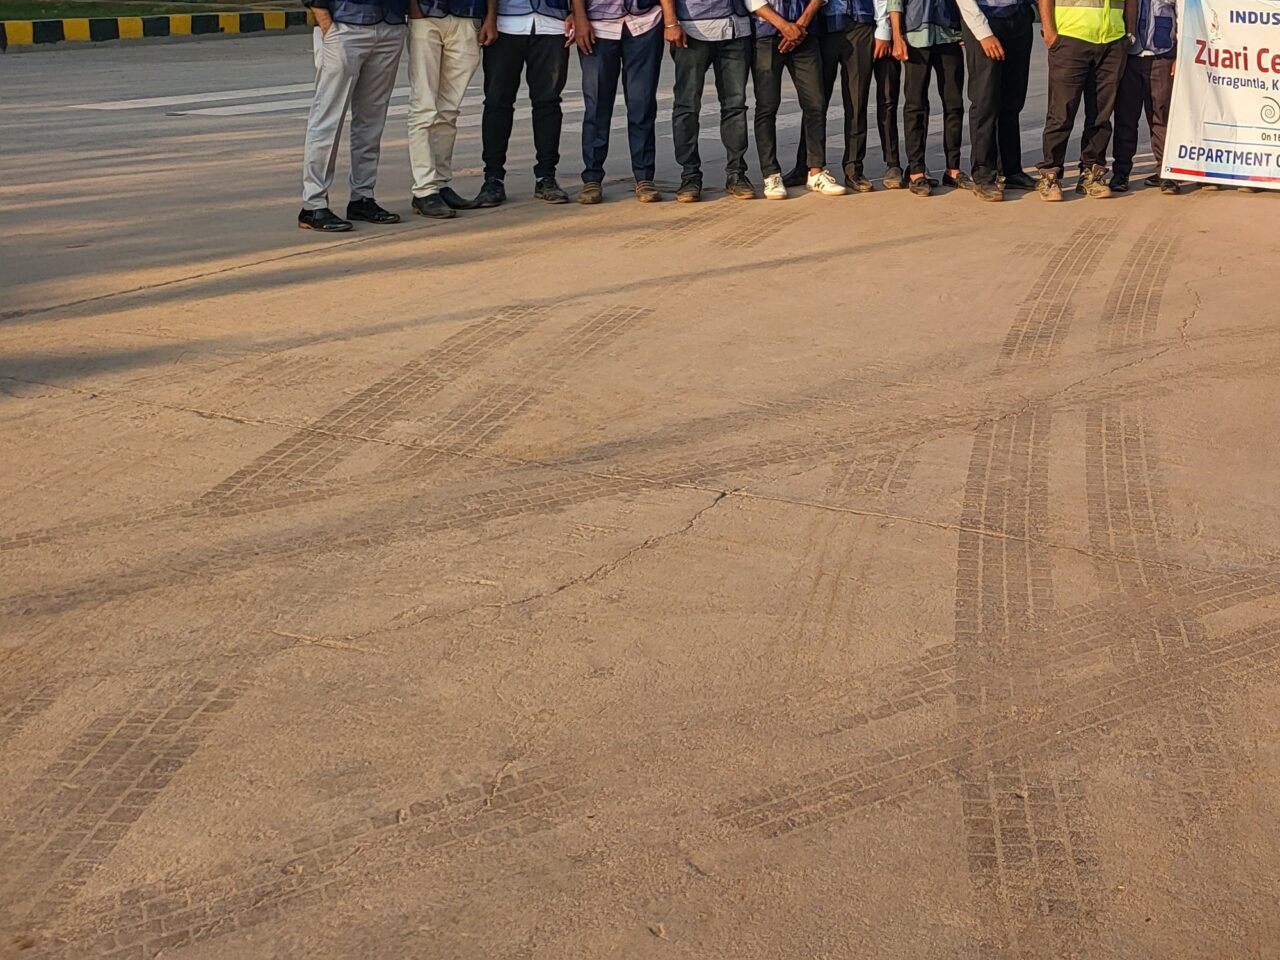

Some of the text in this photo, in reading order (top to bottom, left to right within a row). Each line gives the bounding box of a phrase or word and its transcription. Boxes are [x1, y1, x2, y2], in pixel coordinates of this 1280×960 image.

[1194, 39, 1249, 71] Zuari
[1206, 71, 1269, 90] Yerraguntla,
[1261, 132, 1271, 141] On
[1178, 145, 1272, 167] DEPARTMENT
